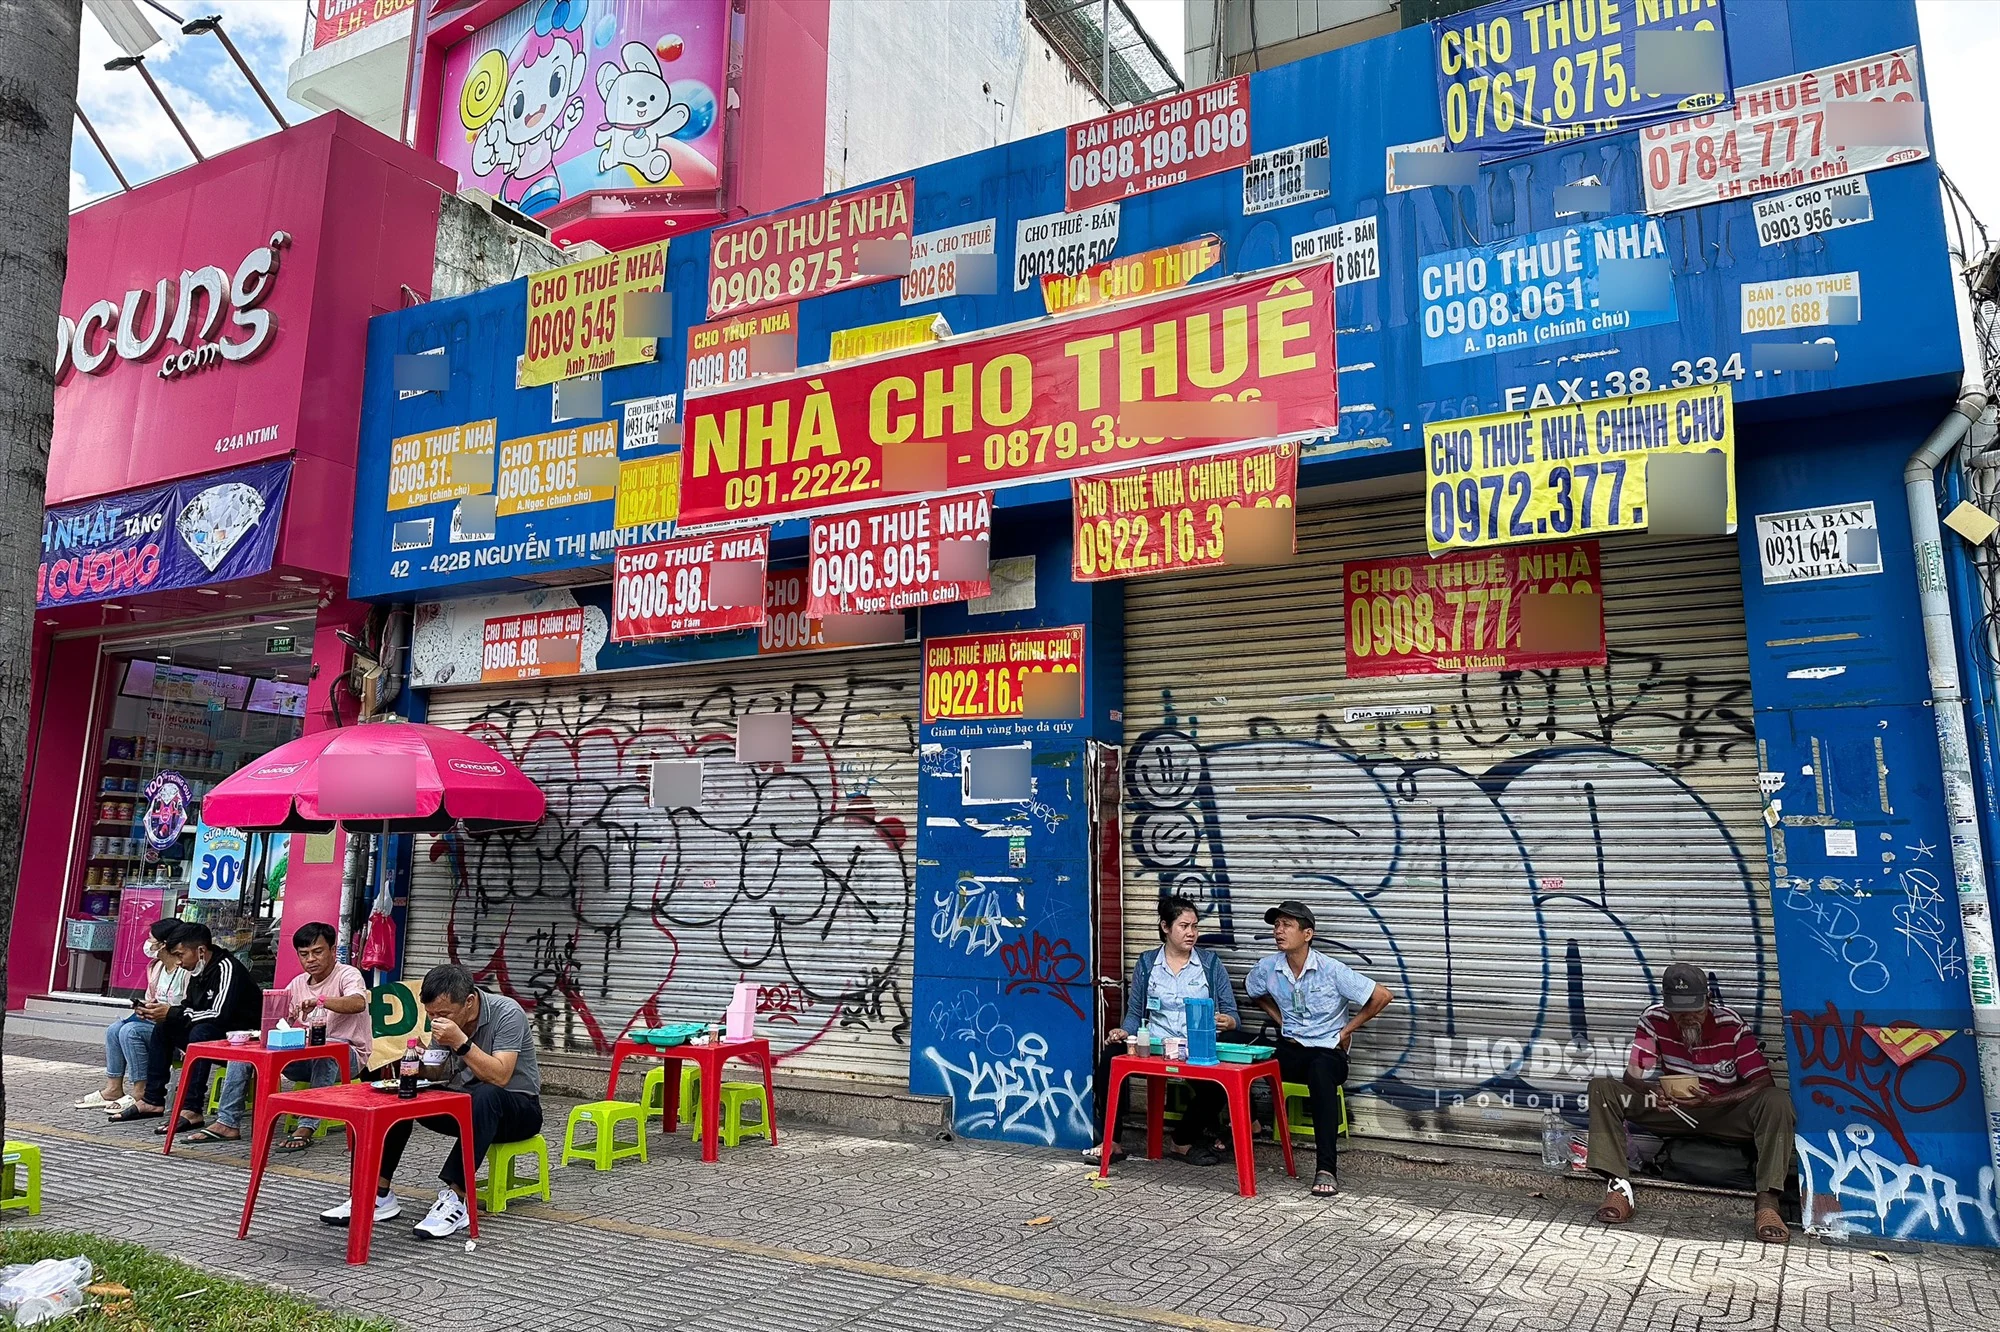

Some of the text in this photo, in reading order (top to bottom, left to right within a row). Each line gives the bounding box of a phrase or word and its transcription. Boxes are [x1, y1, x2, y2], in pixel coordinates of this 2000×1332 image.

[338, 9, 367, 36] LH:
[1440, 16, 1512, 76] CHO
[1834, 52, 1913, 98] NHÀ
[1076, 81, 1239, 150] BÁN HOẶC CHO THUÊ
[1686, 93, 1716, 108] SGH
[1069, 107, 1248, 192] 0898.198.098
[1246, 138, 1328, 175] NHÀ CHO THUÊ
[1649, 126, 1743, 190] 0784
[1124, 170, 1187, 195] A. Hùng
[1718, 155, 1849, 199] LH chính chủ
[1758, 180, 1861, 218] BÁN CHO THUÊ
[713, 183, 908, 270] CHO THUÊ NHÀ
[936, 225, 992, 254] CHO THUÊ
[1025, 208, 1116, 243] CHO THUÊ BÁN
[1294, 219, 1376, 258] CHO THUÊ BÁN
[1761, 213, 1801, 243] 0903
[1804, 206, 1832, 232] 956
[531, 244, 664, 309] CHO THUÊ NHÀ
[1058, 242, 1085, 276] 956
[1347, 247, 1377, 282] 8612
[1422, 229, 1583, 301] CHO THUÊ
[711, 245, 843, 314] 0908 875
[902, 265, 935, 301] 0902
[1098, 263, 1144, 298] CHO
[1748, 274, 1852, 303] BÁN CHO THUÊ
[529, 295, 617, 362] 0909 545
[694, 309, 791, 350] CHO THUÊ NHÀ
[1747, 299, 1821, 329] 0902 688
[1464, 315, 1587, 354] A. Danh (chính
[565, 347, 616, 377] Anh Thành
[688, 350, 725, 391] 0909
[692, 378, 842, 479] NHÀ
[868, 352, 1034, 447] CHO
[1064, 276, 1317, 413] THUÊ
[625, 413, 659, 437] 0931 642
[627, 396, 675, 417] CHO THUÊ NHÀ
[214, 425, 279, 453] 424A NTMK
[392, 418, 494, 466] CHO THUÊ NHÀ
[501, 421, 615, 469] CHO THUÊ NHÀ
[1431, 384, 1725, 477] CHO THUÊ NHÀ CHÍNH CHỦ
[621, 468, 639, 490] CHO
[724, 456, 882, 511] 091.2222.
[1079, 479, 1107, 518] CHO
[1110, 466, 1148, 513] THUÊ
[1152, 460, 1185, 506] NHÀ
[1189, 455, 1238, 502] CHÍNH
[1431, 456, 1662, 543] 0972.377.
[813, 489, 990, 555] CHO THUÊ NHÀ
[1771, 510, 1865, 535] NHÀ BÁN
[474, 531, 550, 567] NGUYỄN
[555, 535, 586, 558] THỊ
[588, 527, 638, 554] MINH
[619, 535, 766, 574] CHO THUÊ NHÀ
[1765, 529, 1840, 567] 0931 642
[1350, 545, 1592, 594] CHO THUÊ NHÀ
[1788, 565, 1822, 580] ANH
[765, 577, 799, 608] CHO
[855, 594, 886, 612] Ngọc
[890, 589, 931, 609] (chính
[274, 638, 290, 646] EXIT
[484, 623, 501, 642] CHO
[502, 618, 521, 639] THUÊ
[522, 616, 538, 638] NHÀ
[539, 612, 564, 635] CHÍNH
[929, 636, 1045, 667] CHO THUÊ NHÀ CHÍNH
[1436, 652, 1506, 670] Anh Khánh
[930, 725, 957, 737] Giám
[986, 723, 1012, 736] vàng
[1014, 722, 1034, 735] bạc
